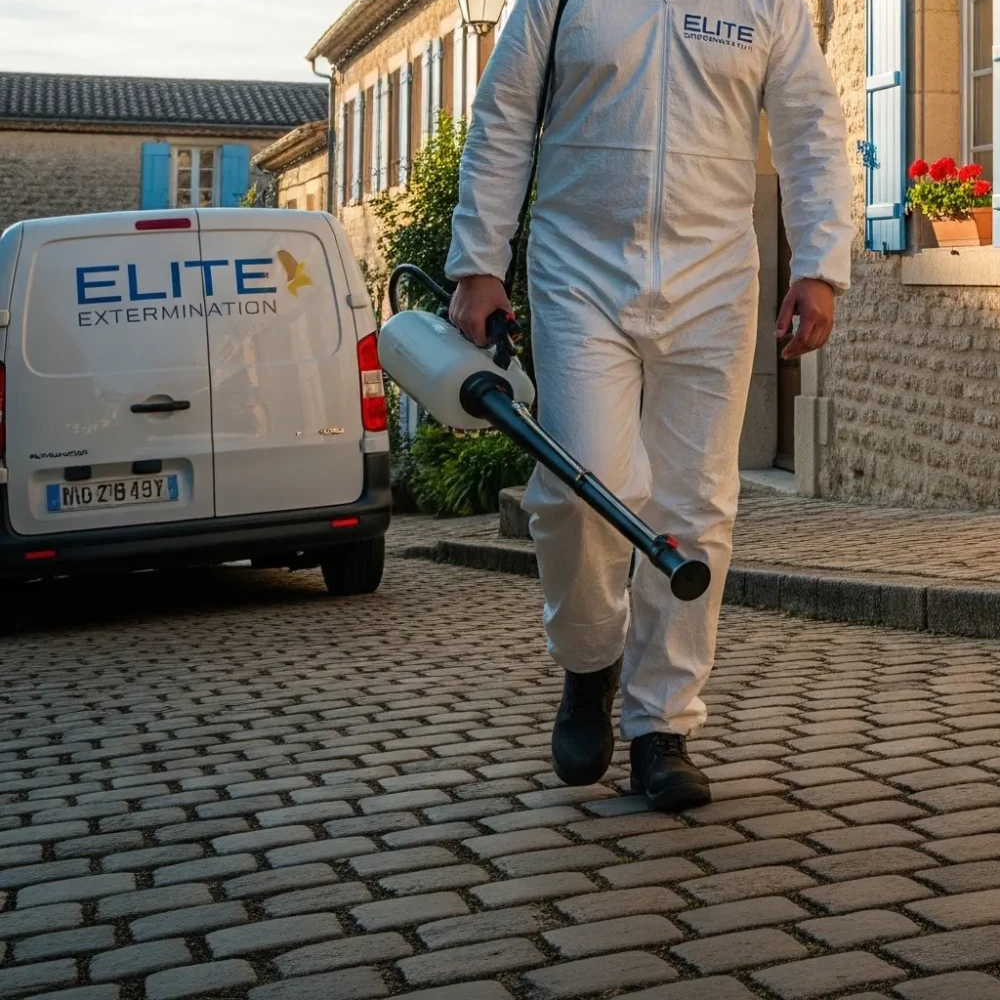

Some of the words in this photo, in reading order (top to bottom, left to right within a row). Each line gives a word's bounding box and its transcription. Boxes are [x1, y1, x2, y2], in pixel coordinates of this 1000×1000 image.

[684, 14, 755, 43] ELITE
[76, 258, 277, 305] ELITE
[78, 299, 277, 327] EXTERMINATION
